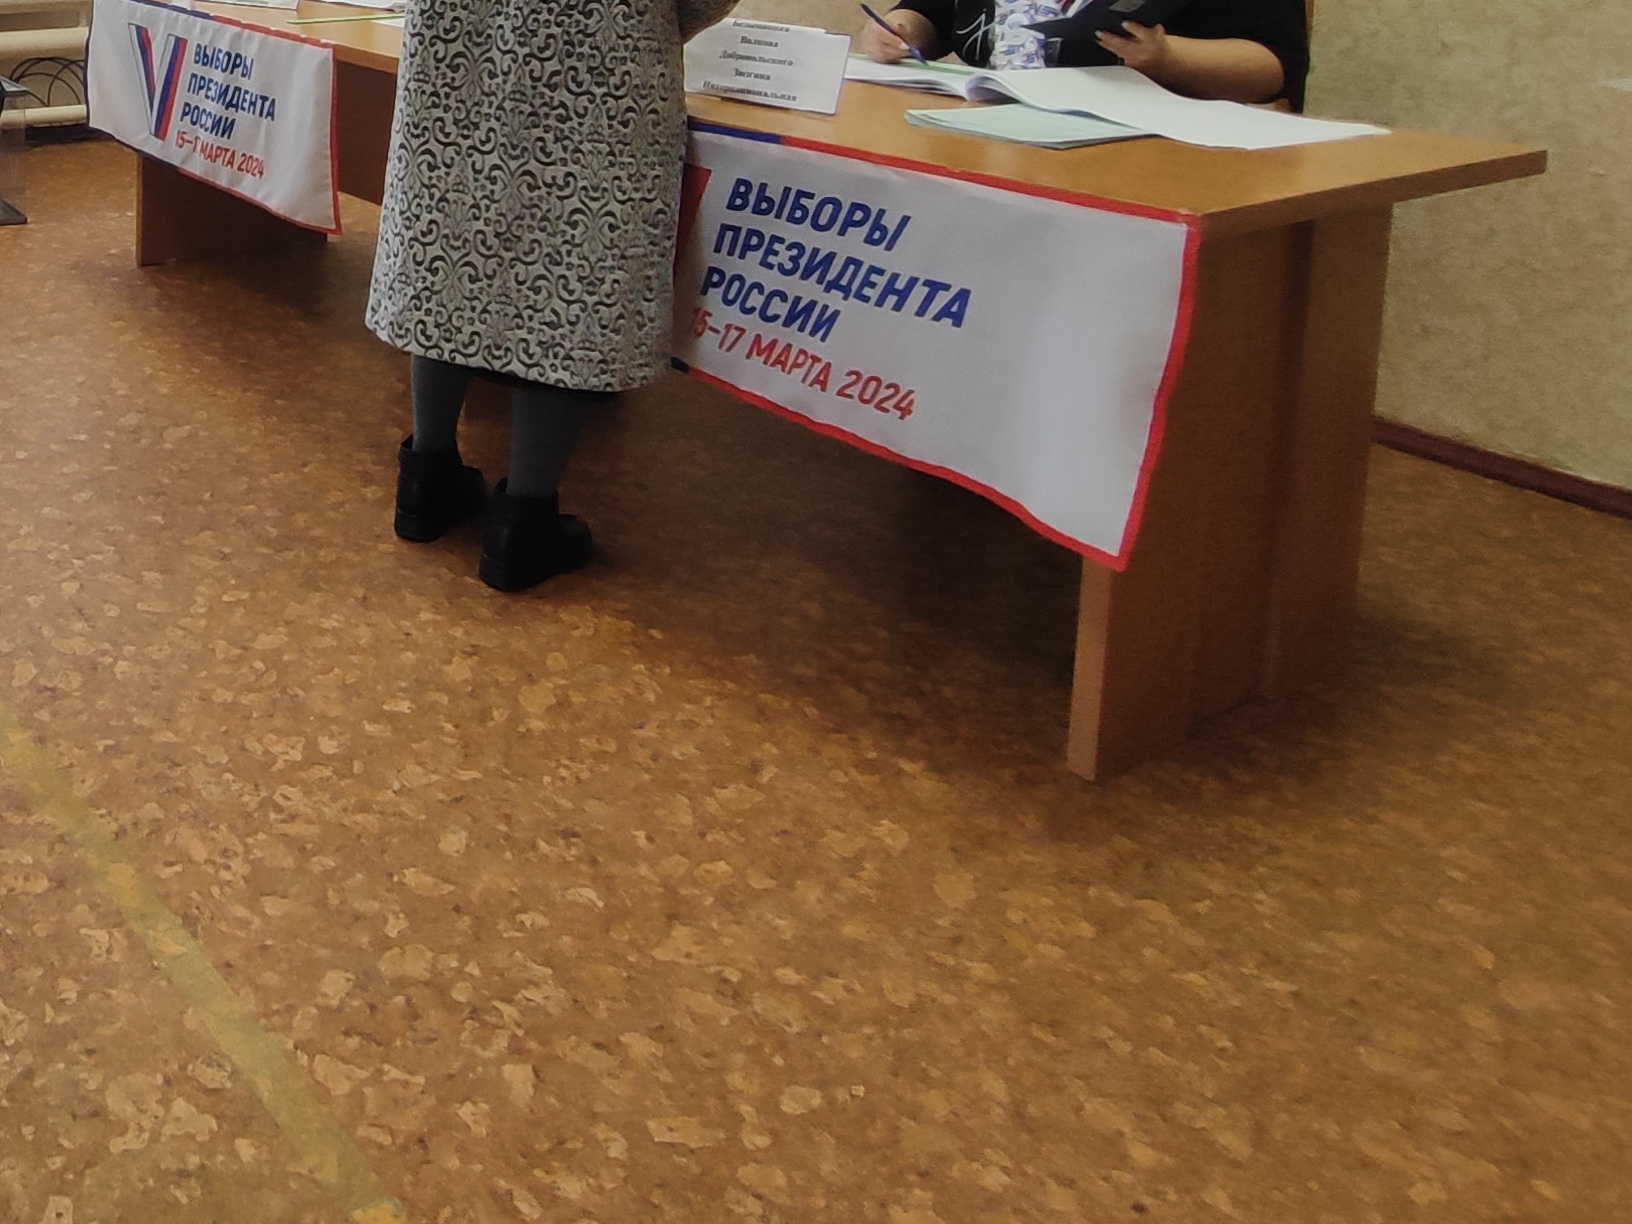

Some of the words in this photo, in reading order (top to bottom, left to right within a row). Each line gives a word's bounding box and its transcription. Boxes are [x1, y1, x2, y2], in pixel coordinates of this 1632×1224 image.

[194, 43, 254, 80] ВЫБОРЫ
[180, 102, 236, 140] РОССИИ
[187, 73, 276, 121] ПРЕЗИДЕНТА
[199, 140, 236, 169] МАРТА
[237, 152, 264, 179] 2024
[725, 177, 911, 252] ВЫБОРЫ
[700, 266, 841, 343] РОССИИ
[713, 223, 972, 328] ПРЕЗИДЕНТА
[745, 333, 833, 393] МАРТА
[836, 370, 915, 420] 2024
